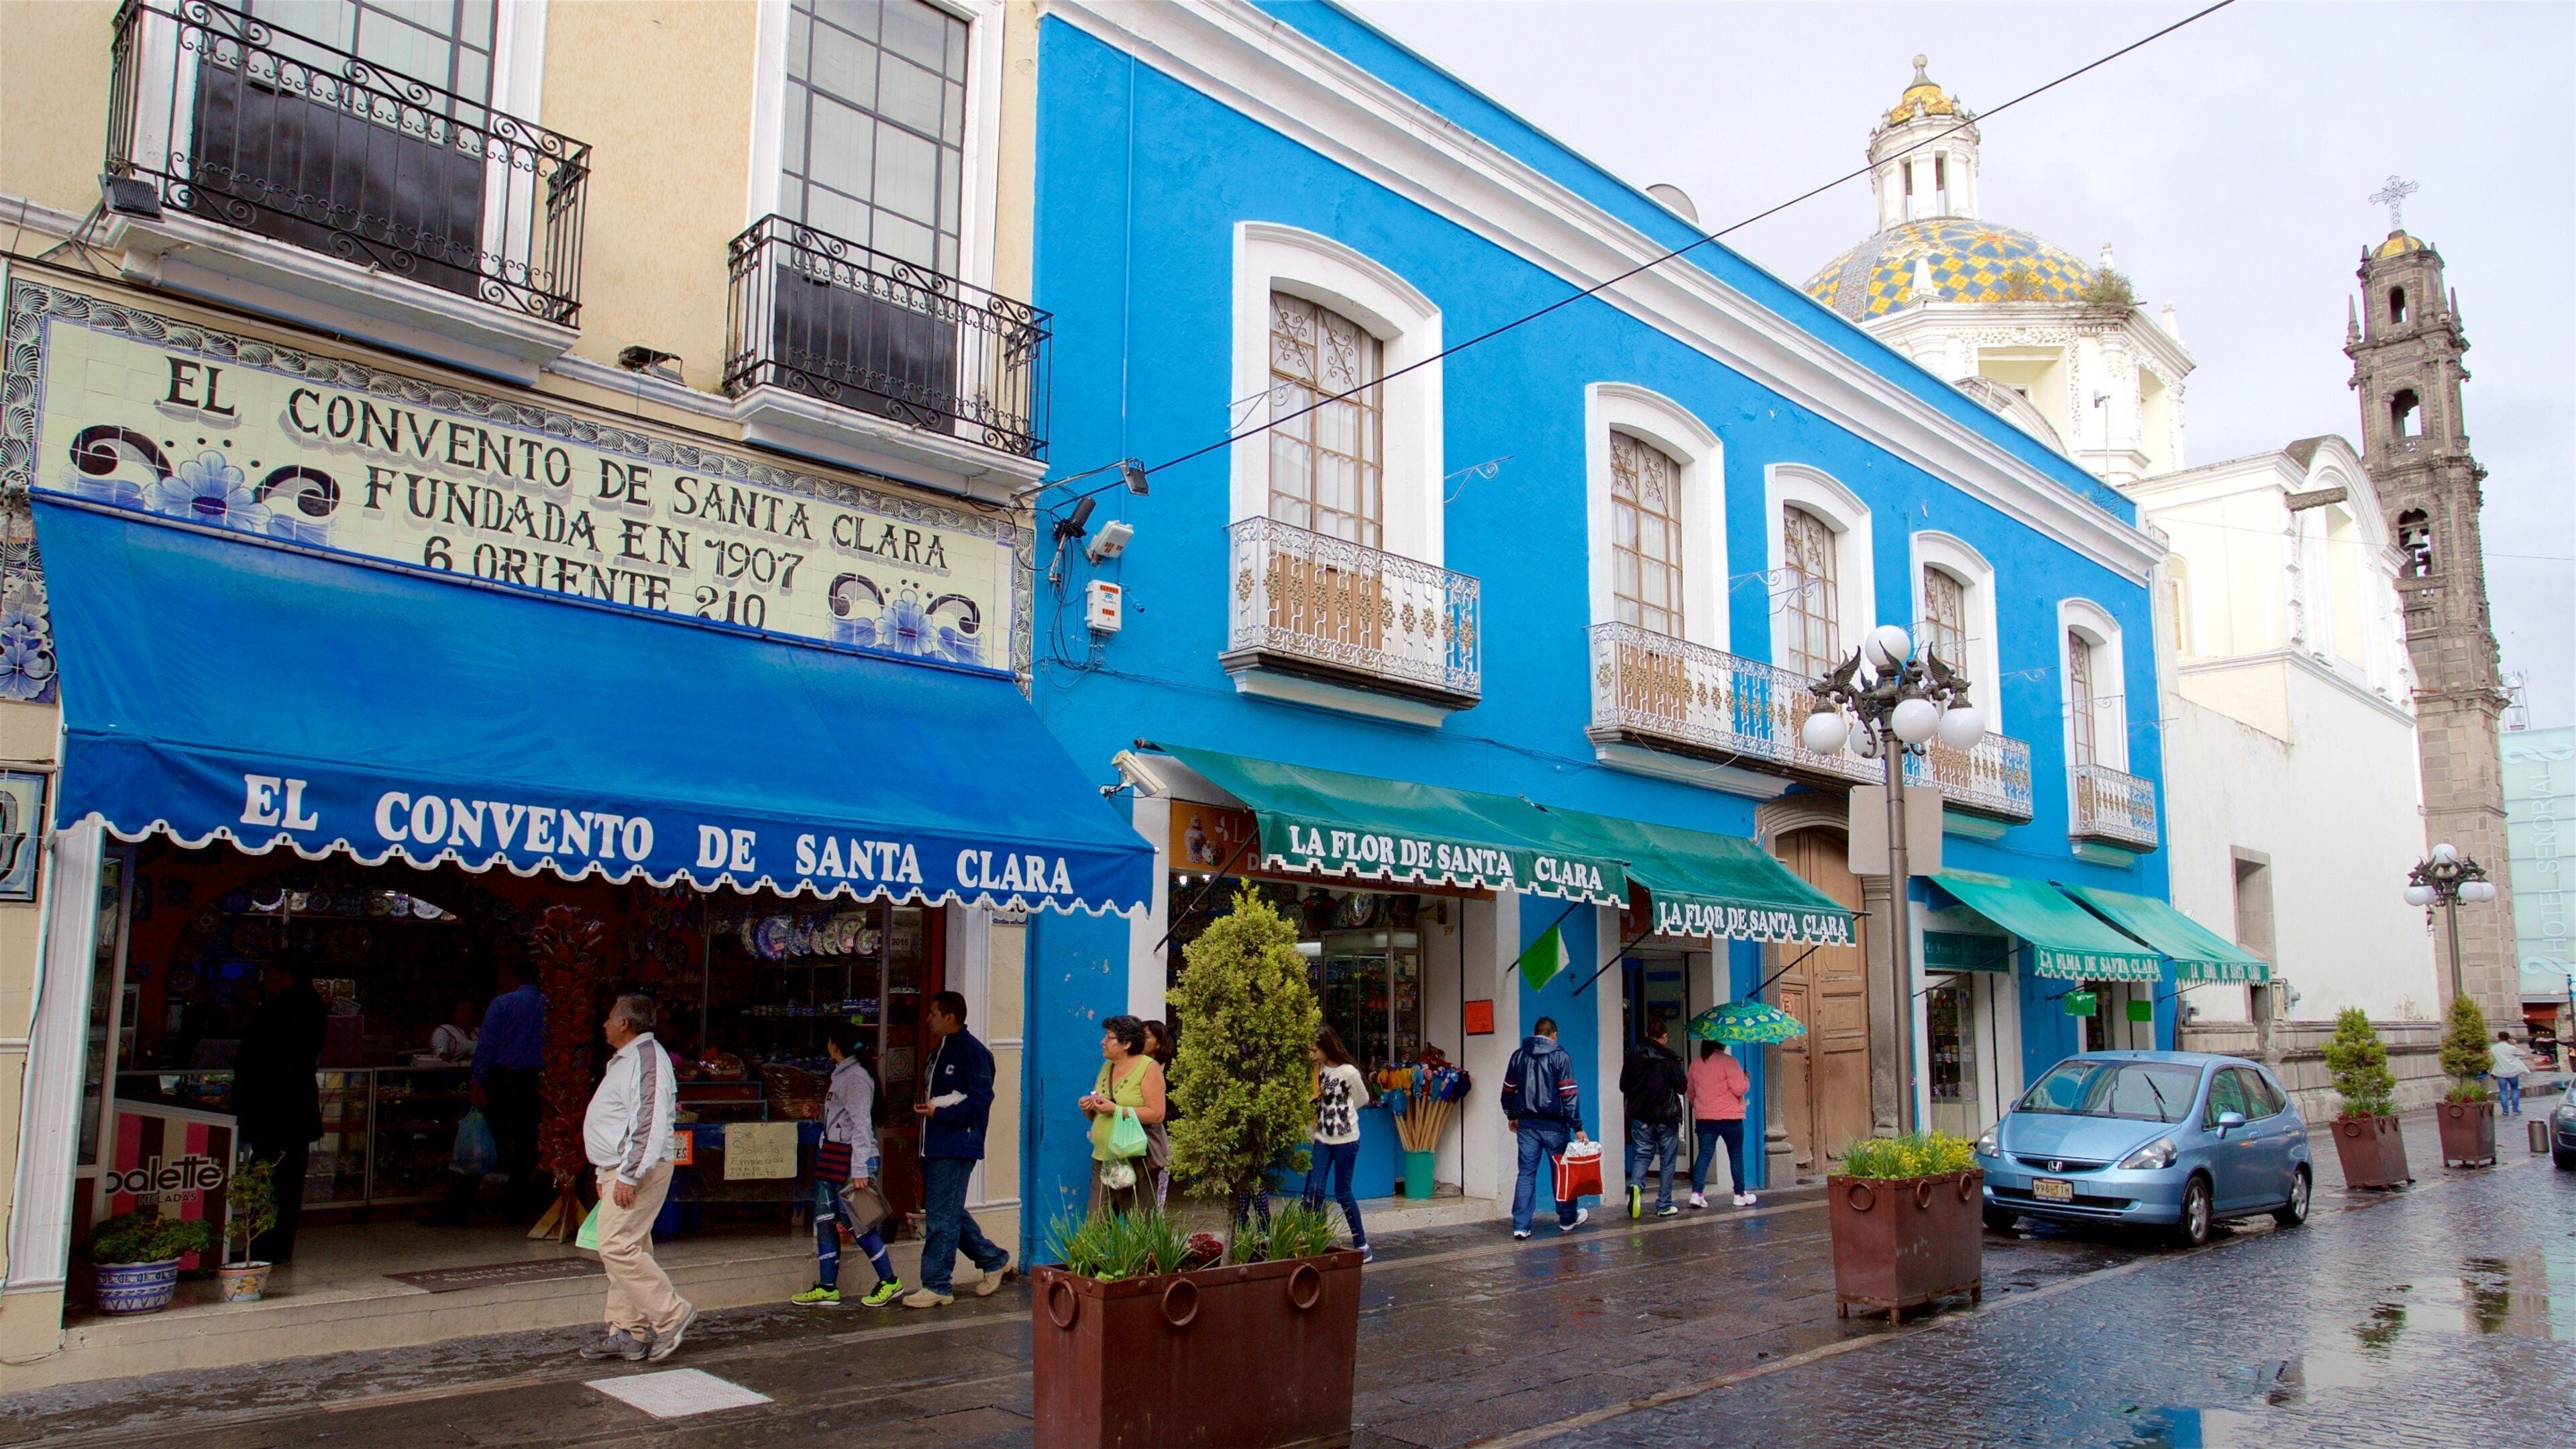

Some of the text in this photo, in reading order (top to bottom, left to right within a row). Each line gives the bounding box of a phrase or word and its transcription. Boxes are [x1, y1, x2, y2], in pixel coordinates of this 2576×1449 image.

[164, 356, 949, 570] EL CONVENTO DE SANTA CLARA
[366, 465, 804, 594] FUNDADA EN 1907
[425, 537, 765, 629] 6 ORIENTE 210
[241, 774, 1074, 895] EL CONVENTO DE SANTA CLARA
[1289, 826, 1326, 857] LA
[1331, 830, 1395, 865] FLOR
[1400, 839, 1433, 869] DE
[1437, 845, 1513, 877] SANTA
[1534, 857, 1603, 891] CLARA
[1659, 902, 1848, 937] LA FLOR DE SANTA CLARA
[891, 938, 908, 946] 2016
[2039, 949, 2053, 968] LA
[2084, 955, 2096, 971] DE
[2100, 957, 2130, 973] SANTA
[2131, 958, 2160, 974] CLARA
[2190, 963, 2198, 978] LA
[945, 1064, 955, 1075] C
[732, 1127, 753, 1139] Se
[139, 1192, 197, 1205] HELADAS
